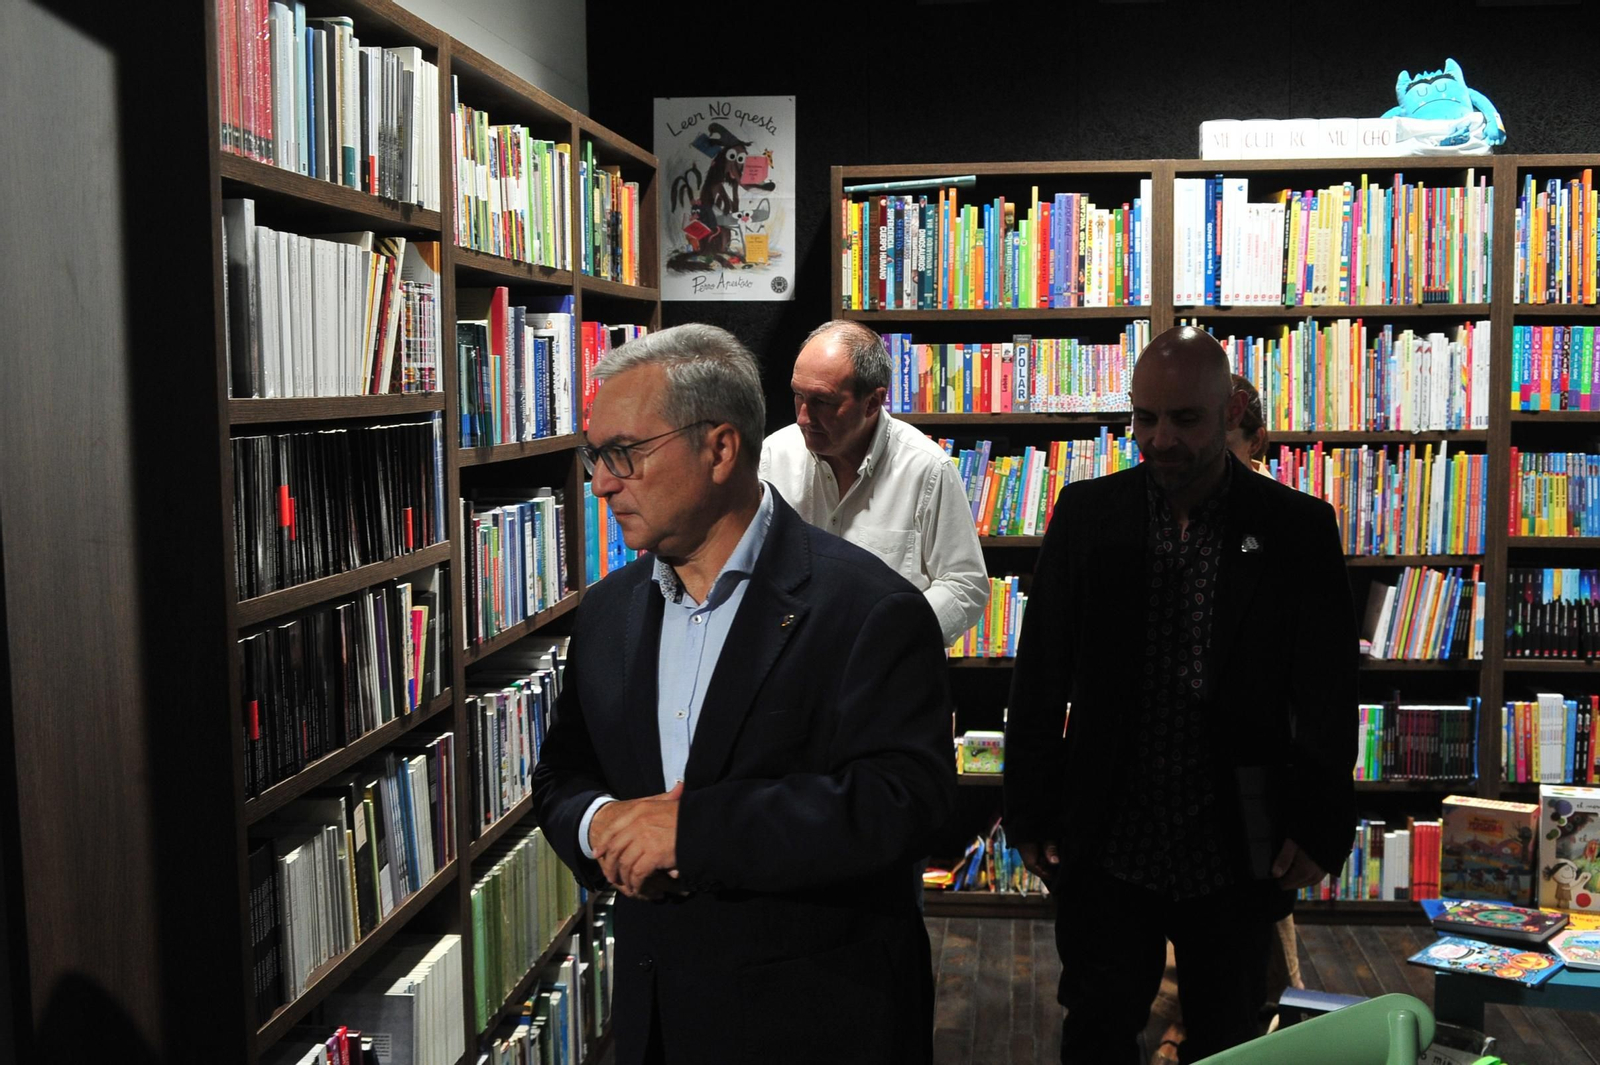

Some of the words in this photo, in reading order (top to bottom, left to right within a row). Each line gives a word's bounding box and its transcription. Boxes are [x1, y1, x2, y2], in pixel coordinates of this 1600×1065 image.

[666, 111, 706, 137] Leer
[708, 101, 732, 118] NO
[734, 108, 778, 136] apesta
[1017, 347, 1026, 399] POLAR
